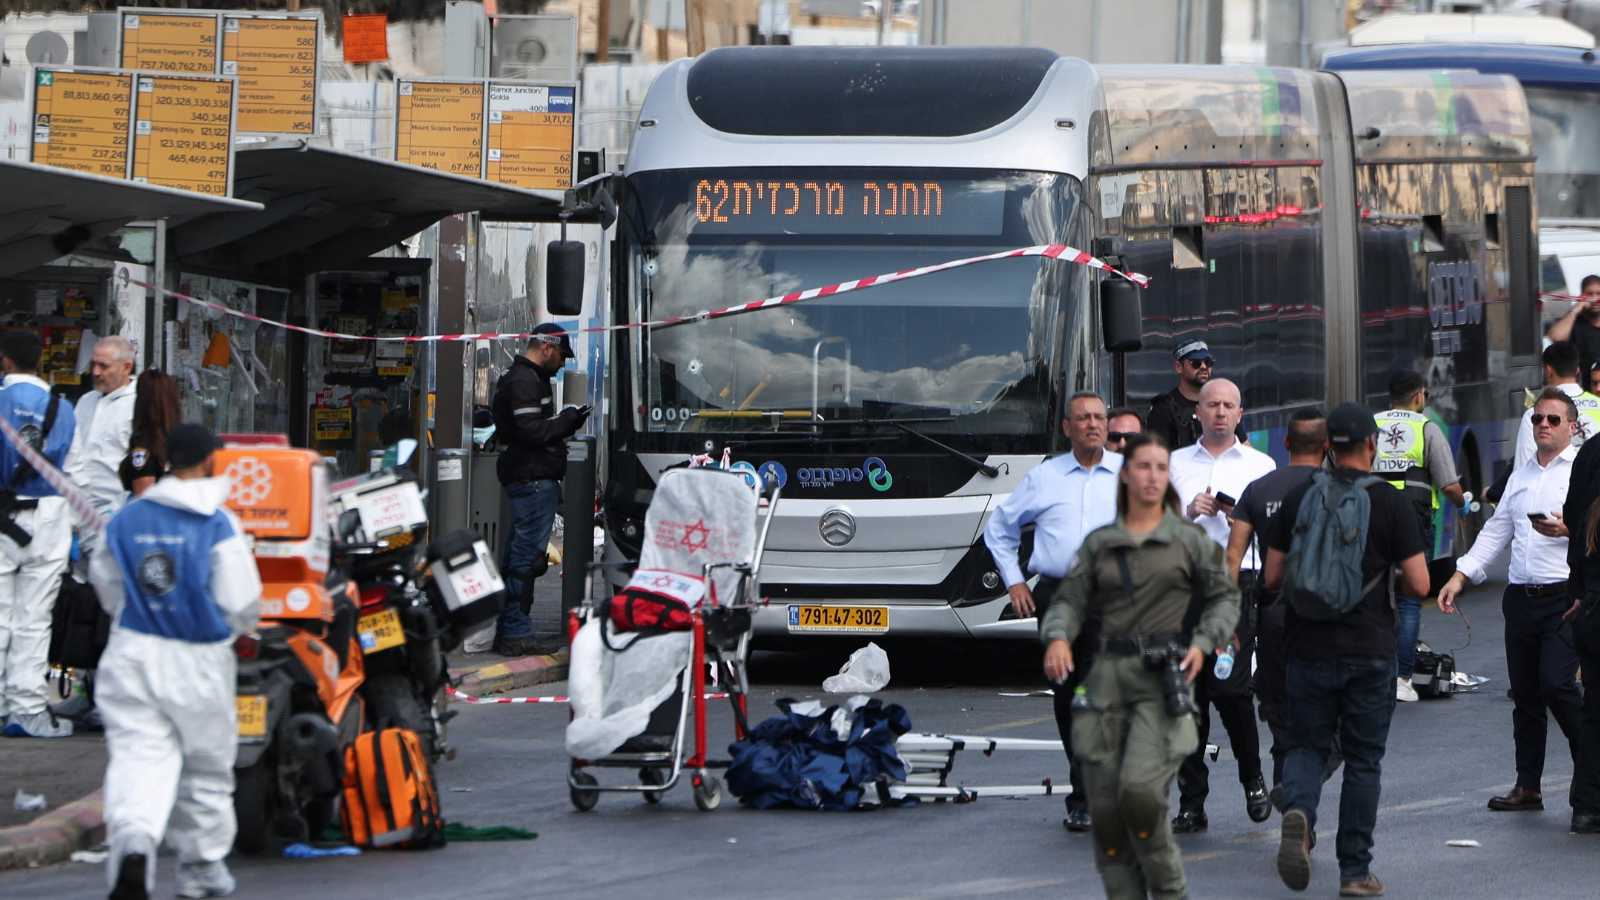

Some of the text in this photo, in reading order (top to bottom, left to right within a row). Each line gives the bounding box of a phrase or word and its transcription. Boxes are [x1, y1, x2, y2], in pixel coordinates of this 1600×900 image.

[297, 37, 314, 46] 580
[491, 86, 512, 94] Ramot
[301, 93, 312, 101] 46
[559, 153, 570, 162] 62
[208, 170, 225, 179] 479
[554, 166, 569, 175] 506
[696, 179, 943, 223] תחנה מרכזית 62
[797, 467, 864, 483] סופרבוס
